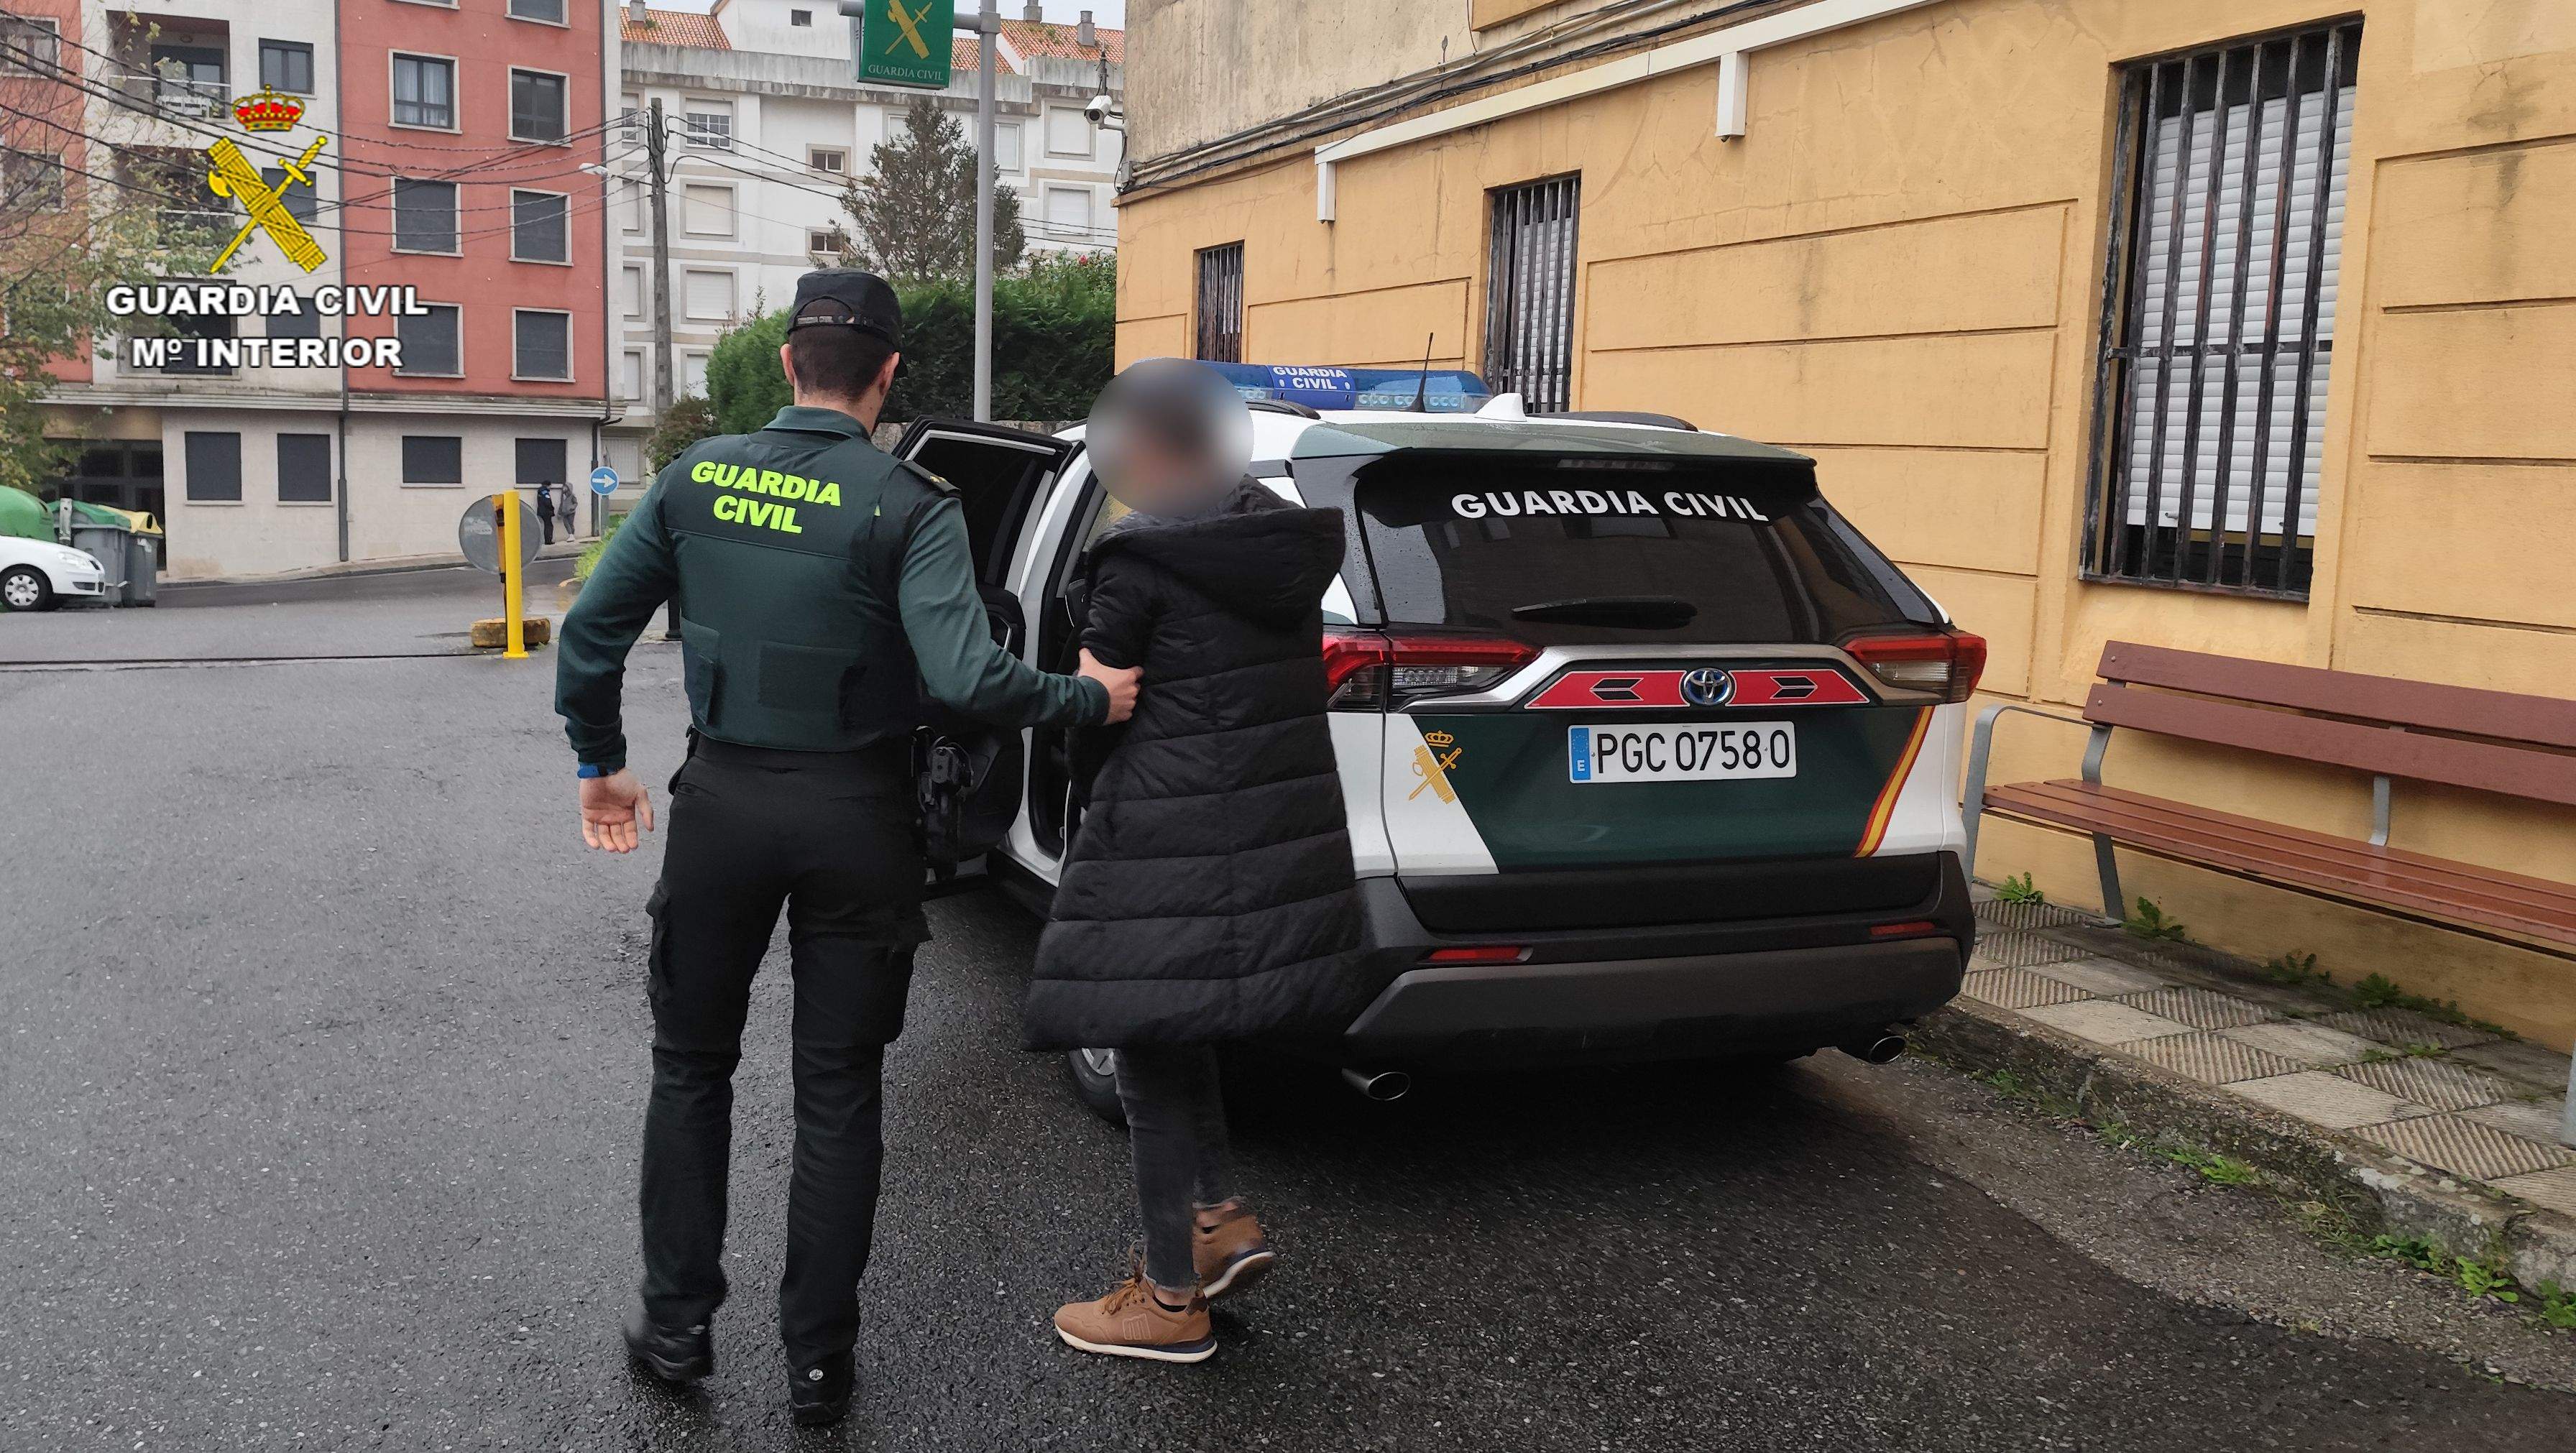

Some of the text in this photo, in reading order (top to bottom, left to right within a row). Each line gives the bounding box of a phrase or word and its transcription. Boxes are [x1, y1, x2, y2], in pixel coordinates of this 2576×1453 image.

[868, 64, 944, 80] GUARDIA CIVIL
[1273, 366, 1348, 378] GUARDIA
[1292, 377, 1338, 389] CIVIL
[691, 461, 841, 507] GUARDIA
[713, 495, 803, 534] CIVIL
[1451, 490, 1770, 522] GUARDIA CIVIL
[1596, 733, 1667, 774] PGC
[1576, 760, 1586, 772] E
